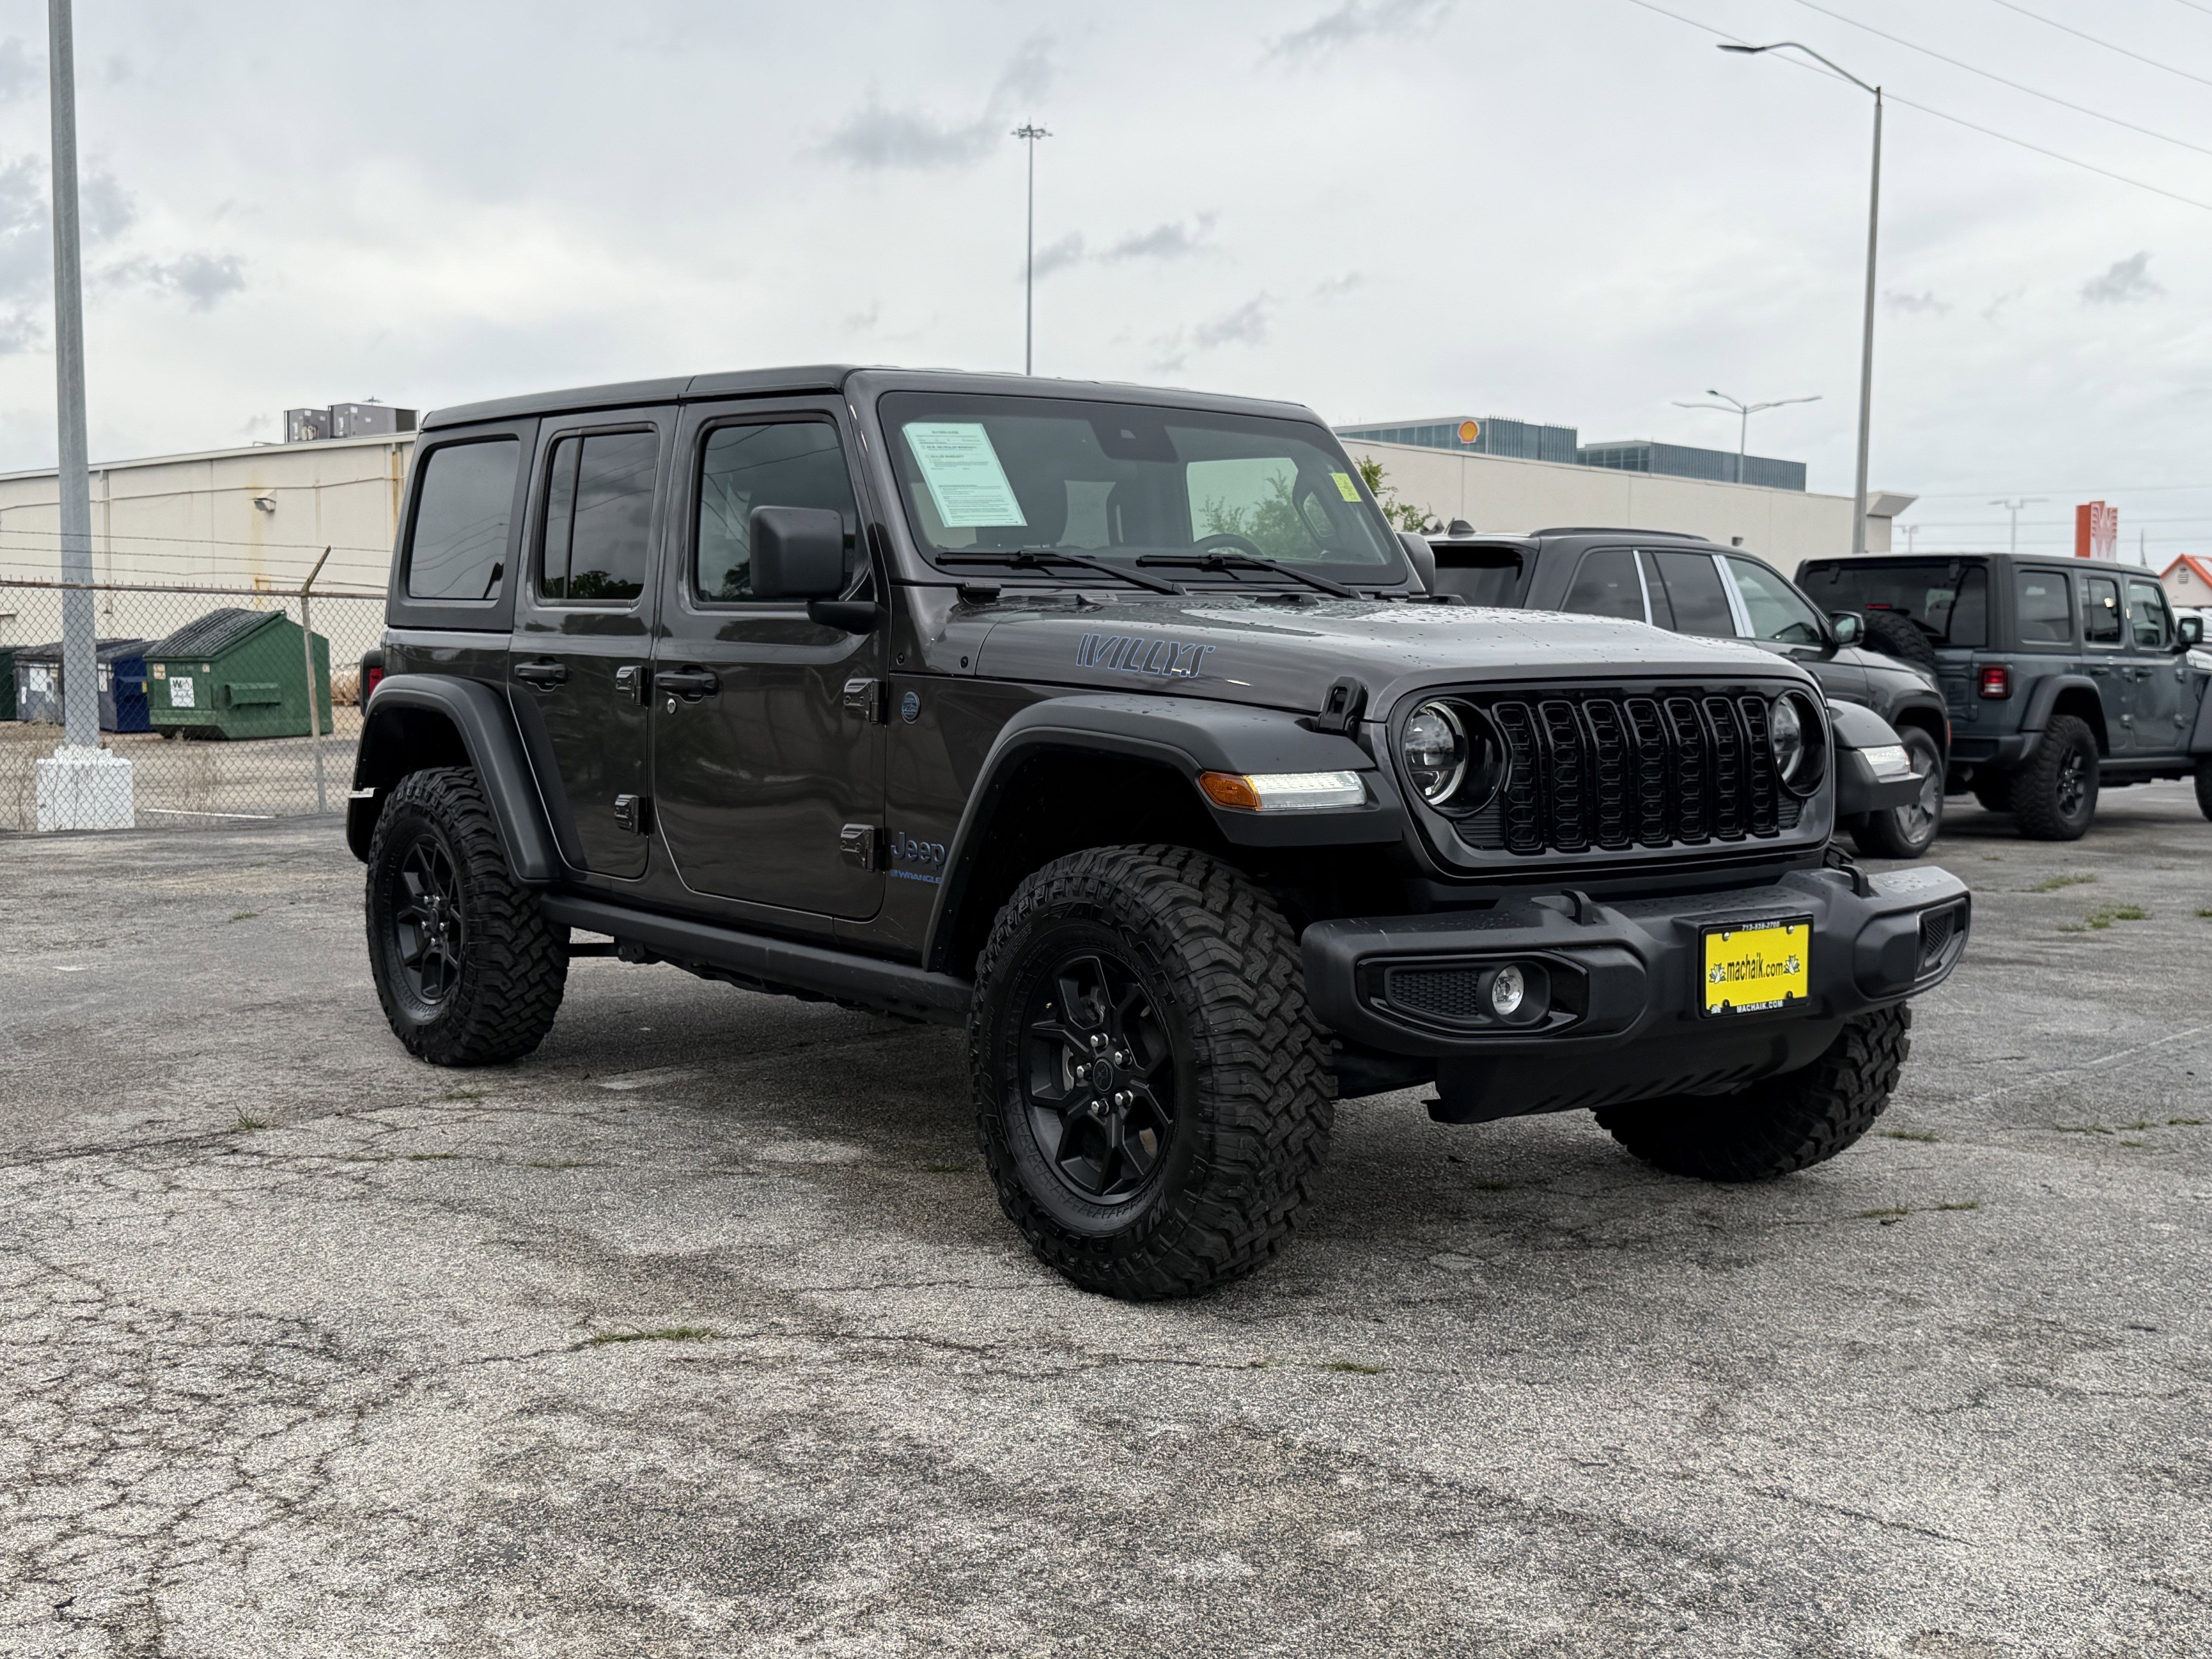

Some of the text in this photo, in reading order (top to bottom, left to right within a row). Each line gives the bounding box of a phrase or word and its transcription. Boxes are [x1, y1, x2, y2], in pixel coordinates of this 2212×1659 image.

[1077, 634, 1215, 678] WILLYS
[890, 831, 946, 871] Jeep
[898, 871, 941, 884] WRANGLE
[1727, 953, 1783, 982] machaik.com
[1736, 1000, 1783, 1013] MACHAIK.COM
